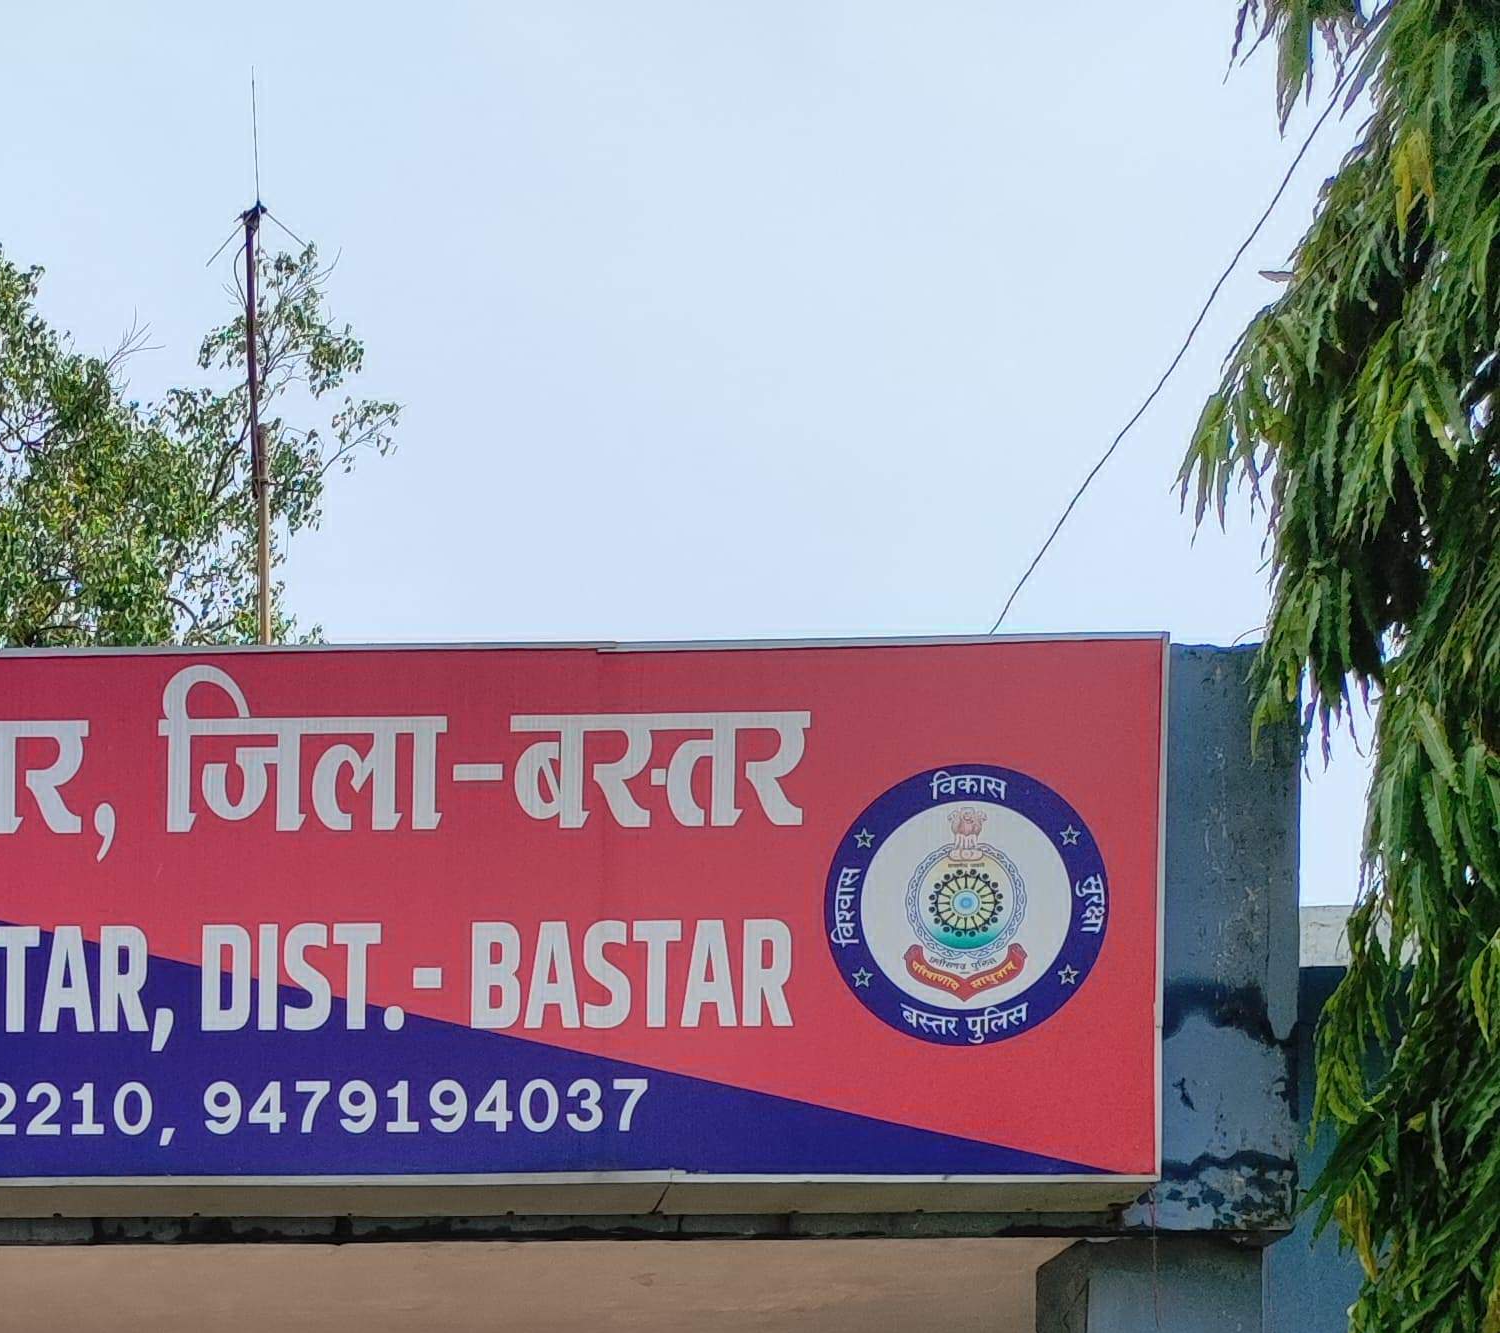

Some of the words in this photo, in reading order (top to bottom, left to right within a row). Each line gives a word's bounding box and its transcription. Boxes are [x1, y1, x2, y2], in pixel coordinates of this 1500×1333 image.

[158, 665, 811, 832] जिला-बस्तर
[930, 771, 1007, 800] विकास
[471, 919, 793, 1028] BASTAR
[900, 1003, 959, 1037] बस्तर
[965, 1002, 1029, 1044] पुलिस
[204, 1079, 647, 1134] 9479194037
